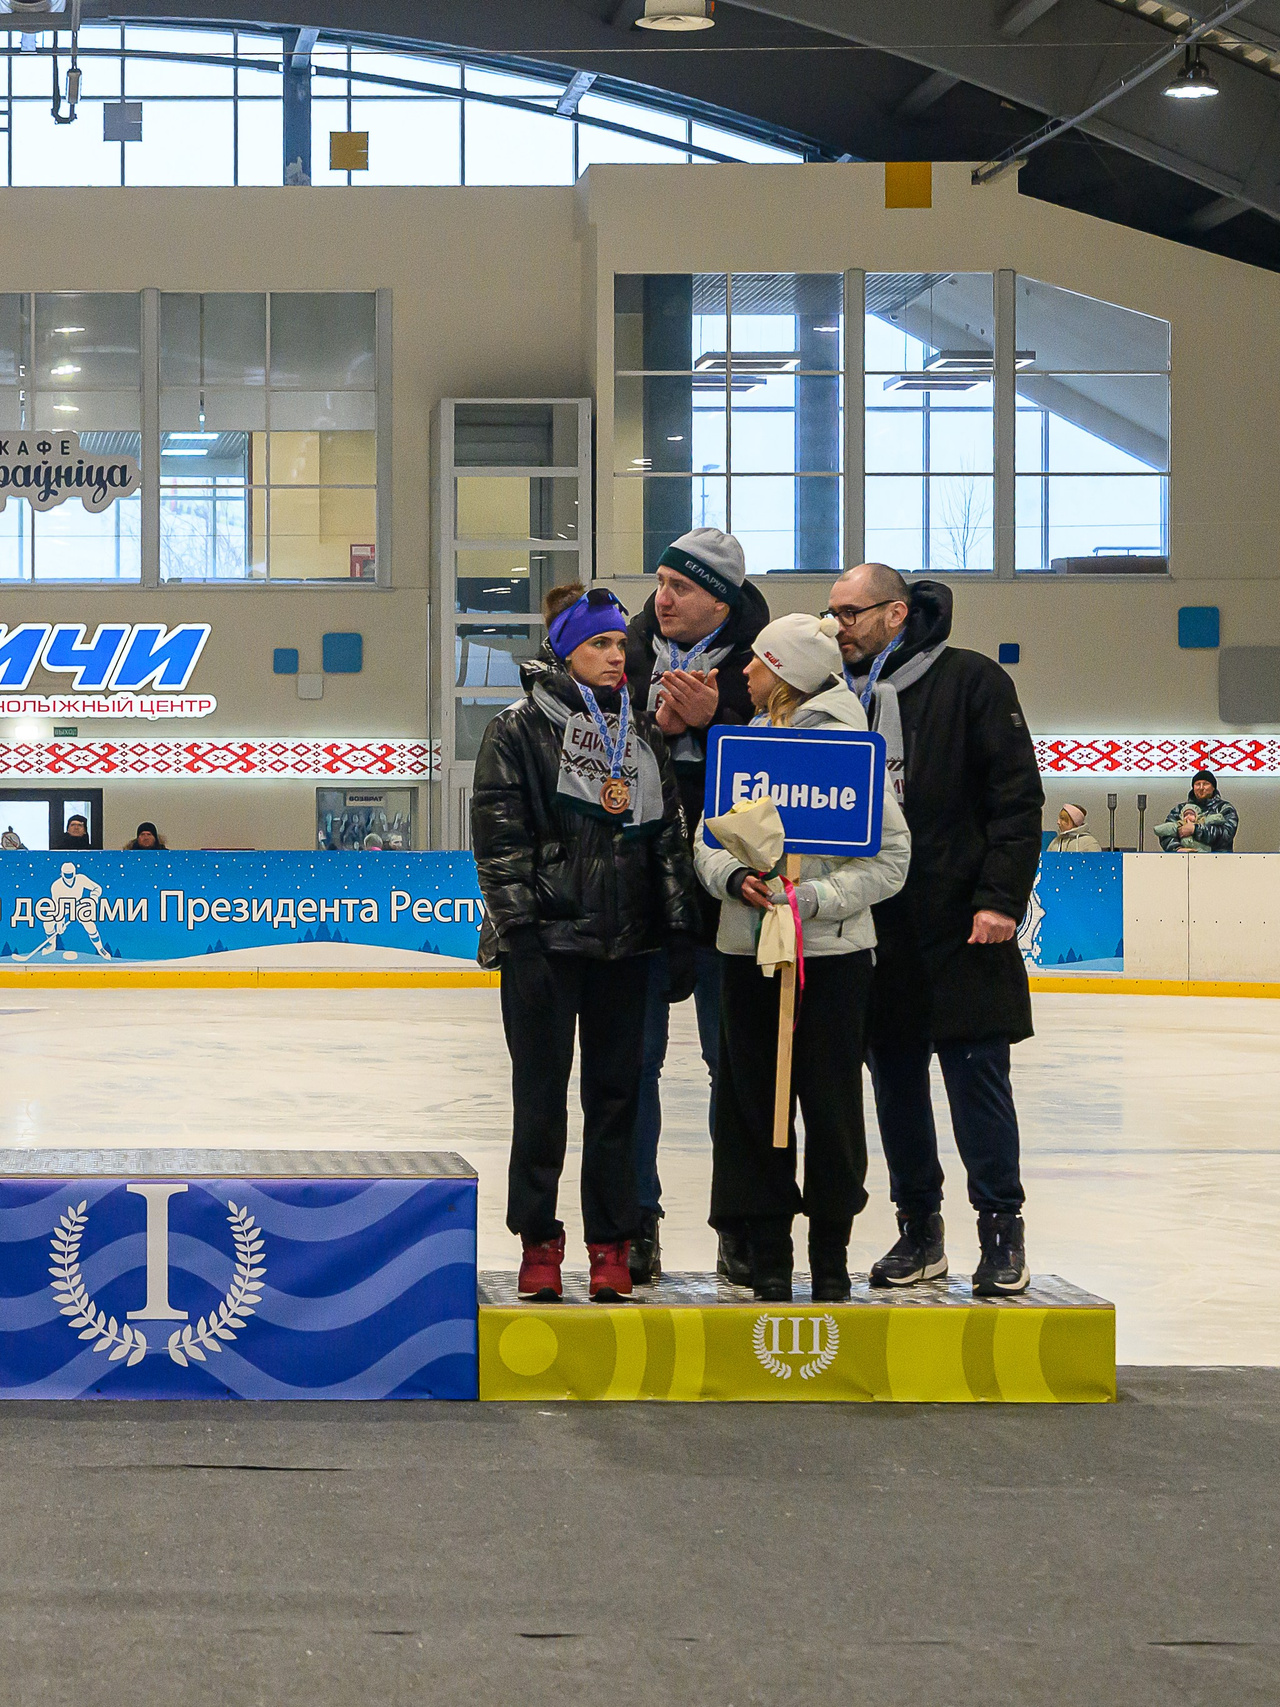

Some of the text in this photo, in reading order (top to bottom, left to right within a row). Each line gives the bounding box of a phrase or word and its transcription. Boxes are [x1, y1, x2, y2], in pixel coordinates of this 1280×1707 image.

[685, 560, 727, 595] БЕЛАРУСЬ
[140, 700, 211, 715] ЦЕНТР
[732, 771, 857, 811] Единые
[10, 896, 149, 929] делами
[159, 889, 379, 931] Президента
[767, 1317, 826, 1354] III
